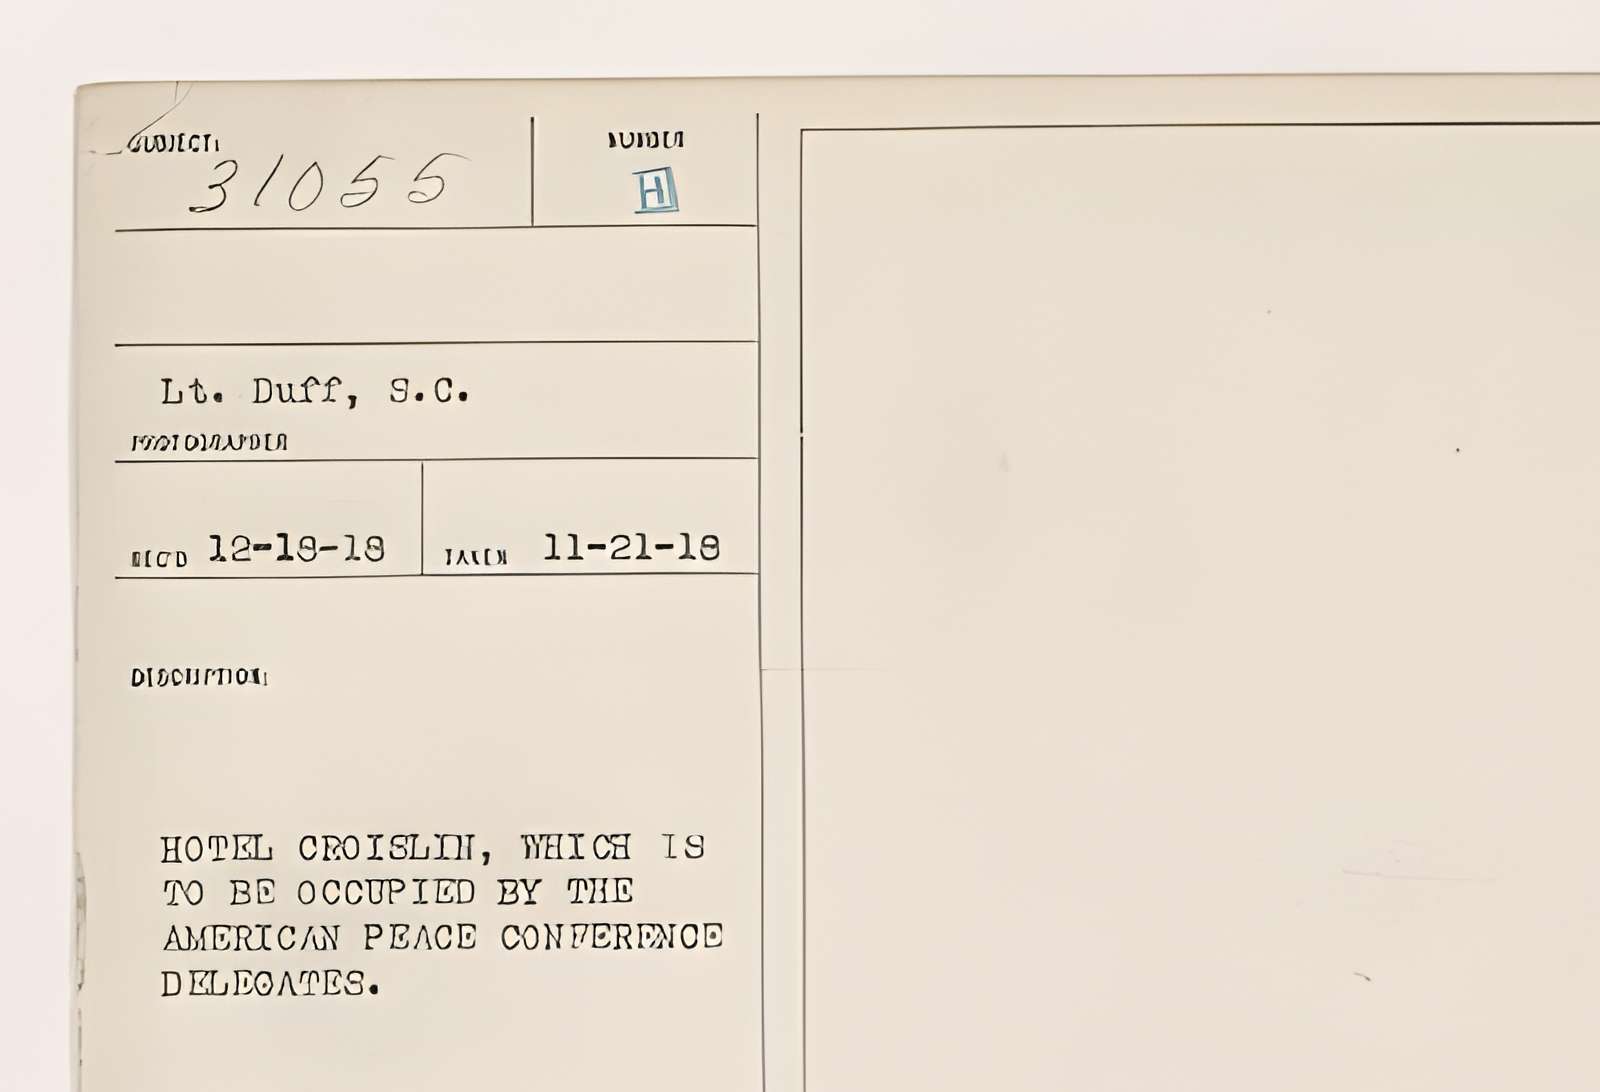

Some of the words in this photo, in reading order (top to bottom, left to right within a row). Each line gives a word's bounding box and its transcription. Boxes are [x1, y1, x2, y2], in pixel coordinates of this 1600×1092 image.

[188, 152, 470, 213] 31055
[160, 377, 223, 405] Lt.
[251, 375, 358, 411] Duff,
[389, 376, 468, 404] S.C.
[543, 532, 721, 561] 11-21-18
[160, 833, 274, 864] HOTEL
[519, 832, 632, 861] WHICH
[661, 833, 705, 860] IS
[163, 879, 204, 907] TO
[229, 878, 276, 906] BE
[297, 877, 476, 906] OCCUPIED
[496, 877, 543, 906] BY
[566, 876, 634, 905] THE
[162, 923, 341, 952] AMERICAN
[363, 922, 477, 951] PEACE
[500, 922, 723, 951] CONFERENCE
